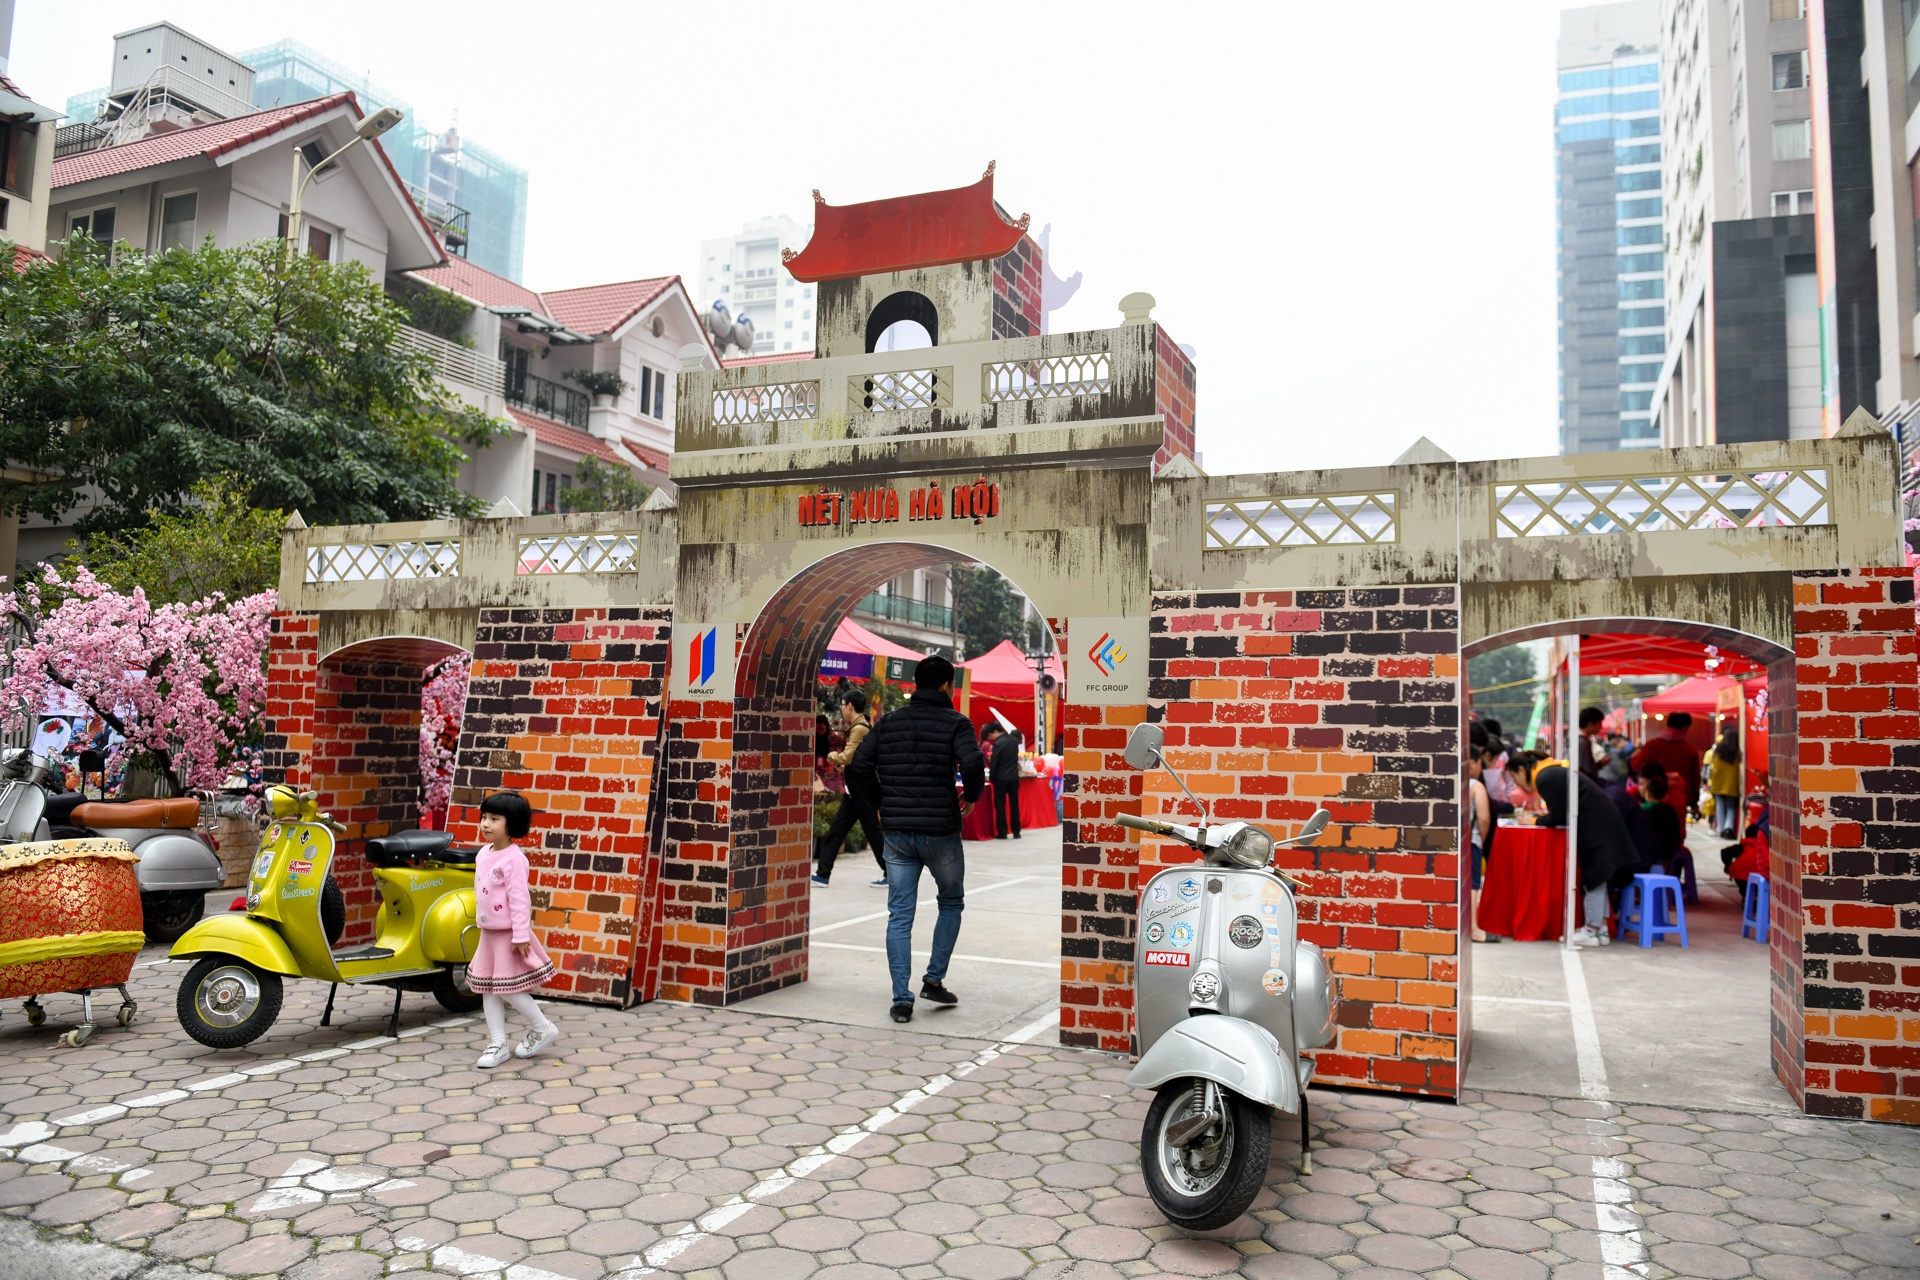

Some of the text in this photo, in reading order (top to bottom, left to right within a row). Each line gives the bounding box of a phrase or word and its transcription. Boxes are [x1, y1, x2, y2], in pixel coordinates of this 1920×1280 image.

[850, 487, 900, 524] XƯA
[909, 480, 944, 521] HÀ
[952, 477, 1000, 525] NỘI
[1086, 684, 1129, 692] FFC GROUP
[1231, 927, 1263, 940] ROCK
[1146, 952, 1188, 965] MOTUL
